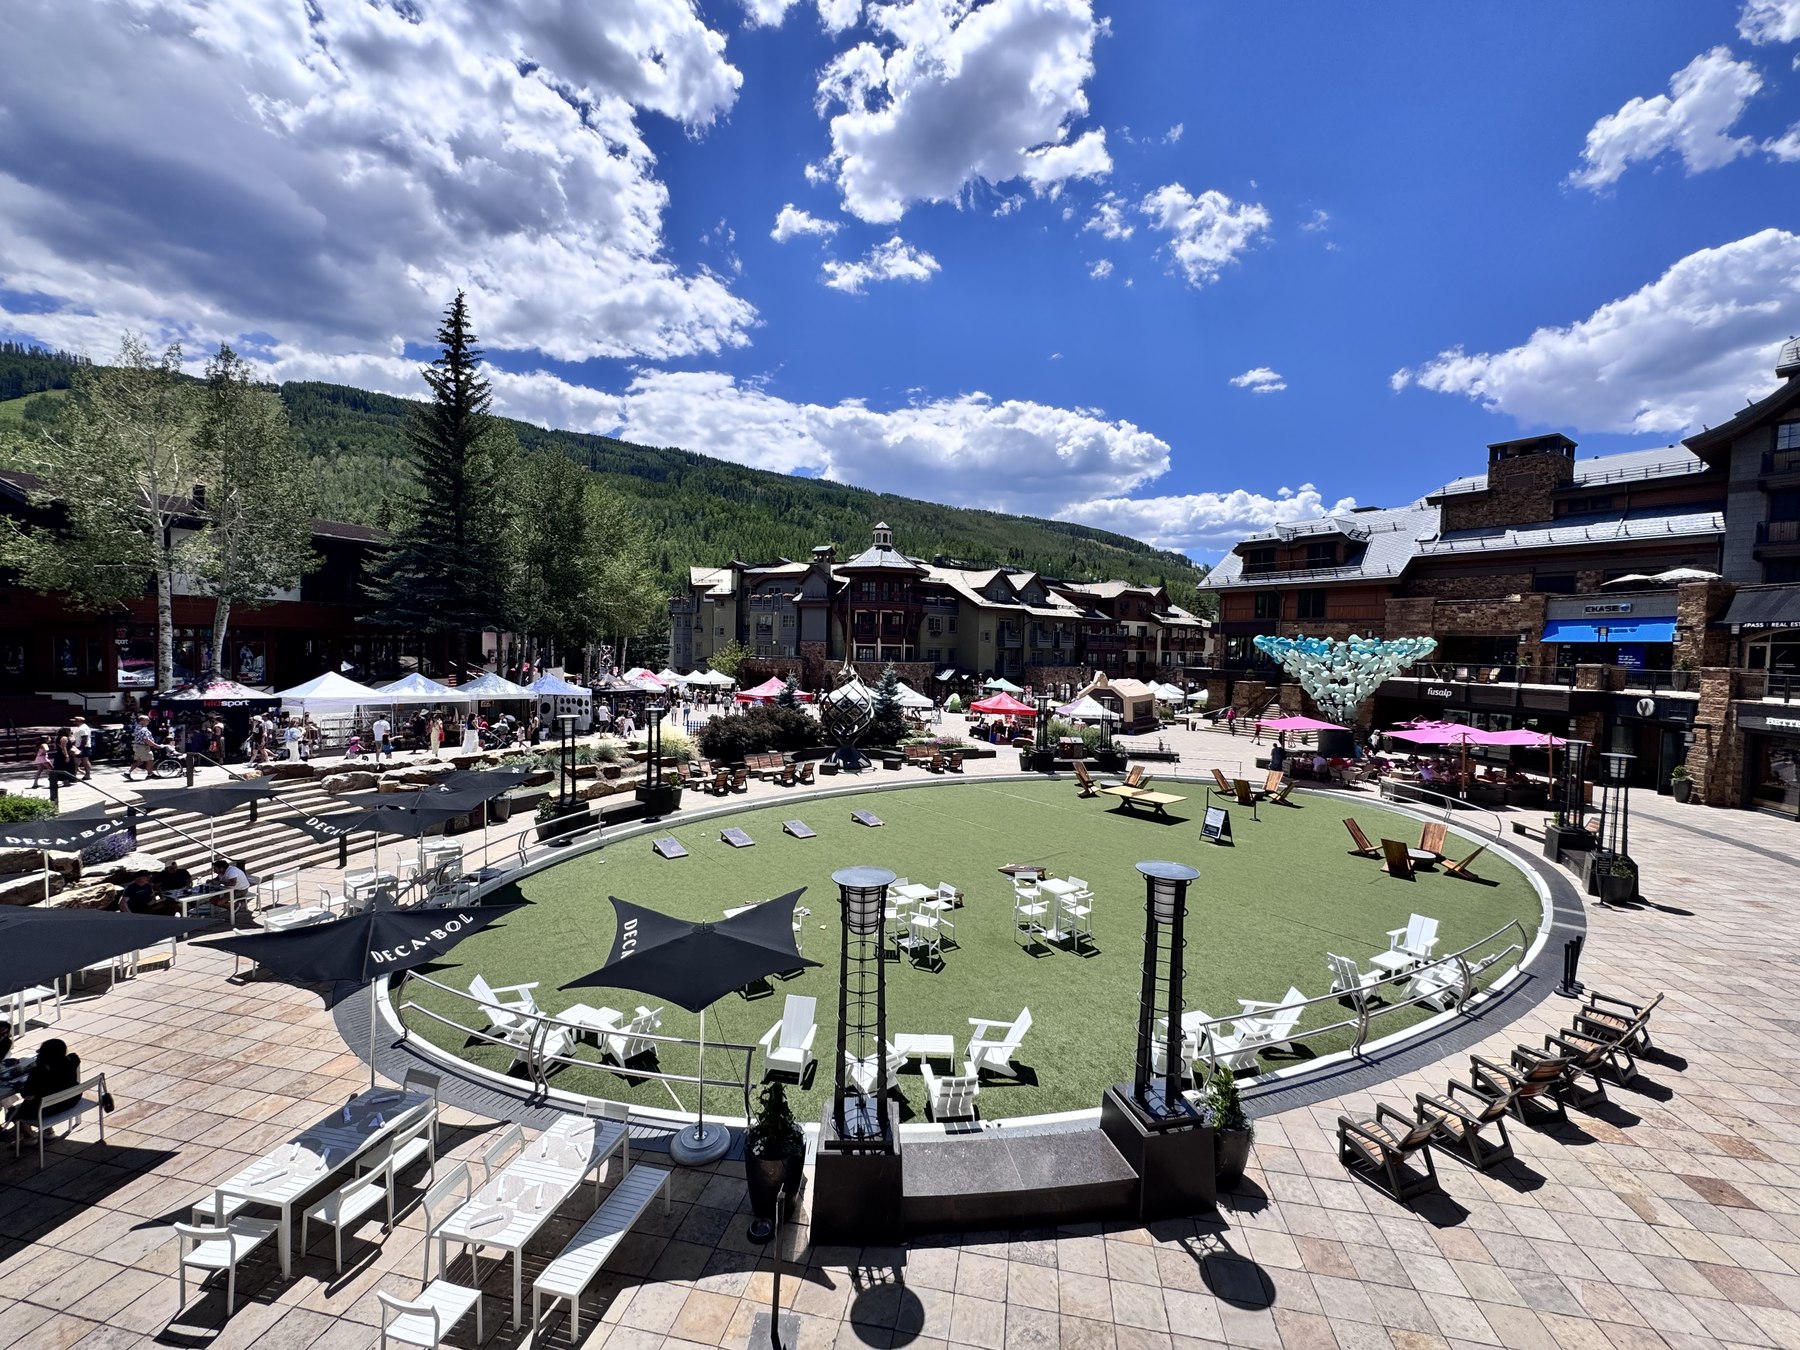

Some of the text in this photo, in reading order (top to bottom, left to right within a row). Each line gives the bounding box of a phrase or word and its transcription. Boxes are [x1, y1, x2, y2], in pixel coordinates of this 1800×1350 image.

[1585, 605, 1619, 613] CHASE
[1427, 686, 1452, 699] fusalp
[203, 700, 250, 708] kidsport
[620, 918, 638, 960] DECA
